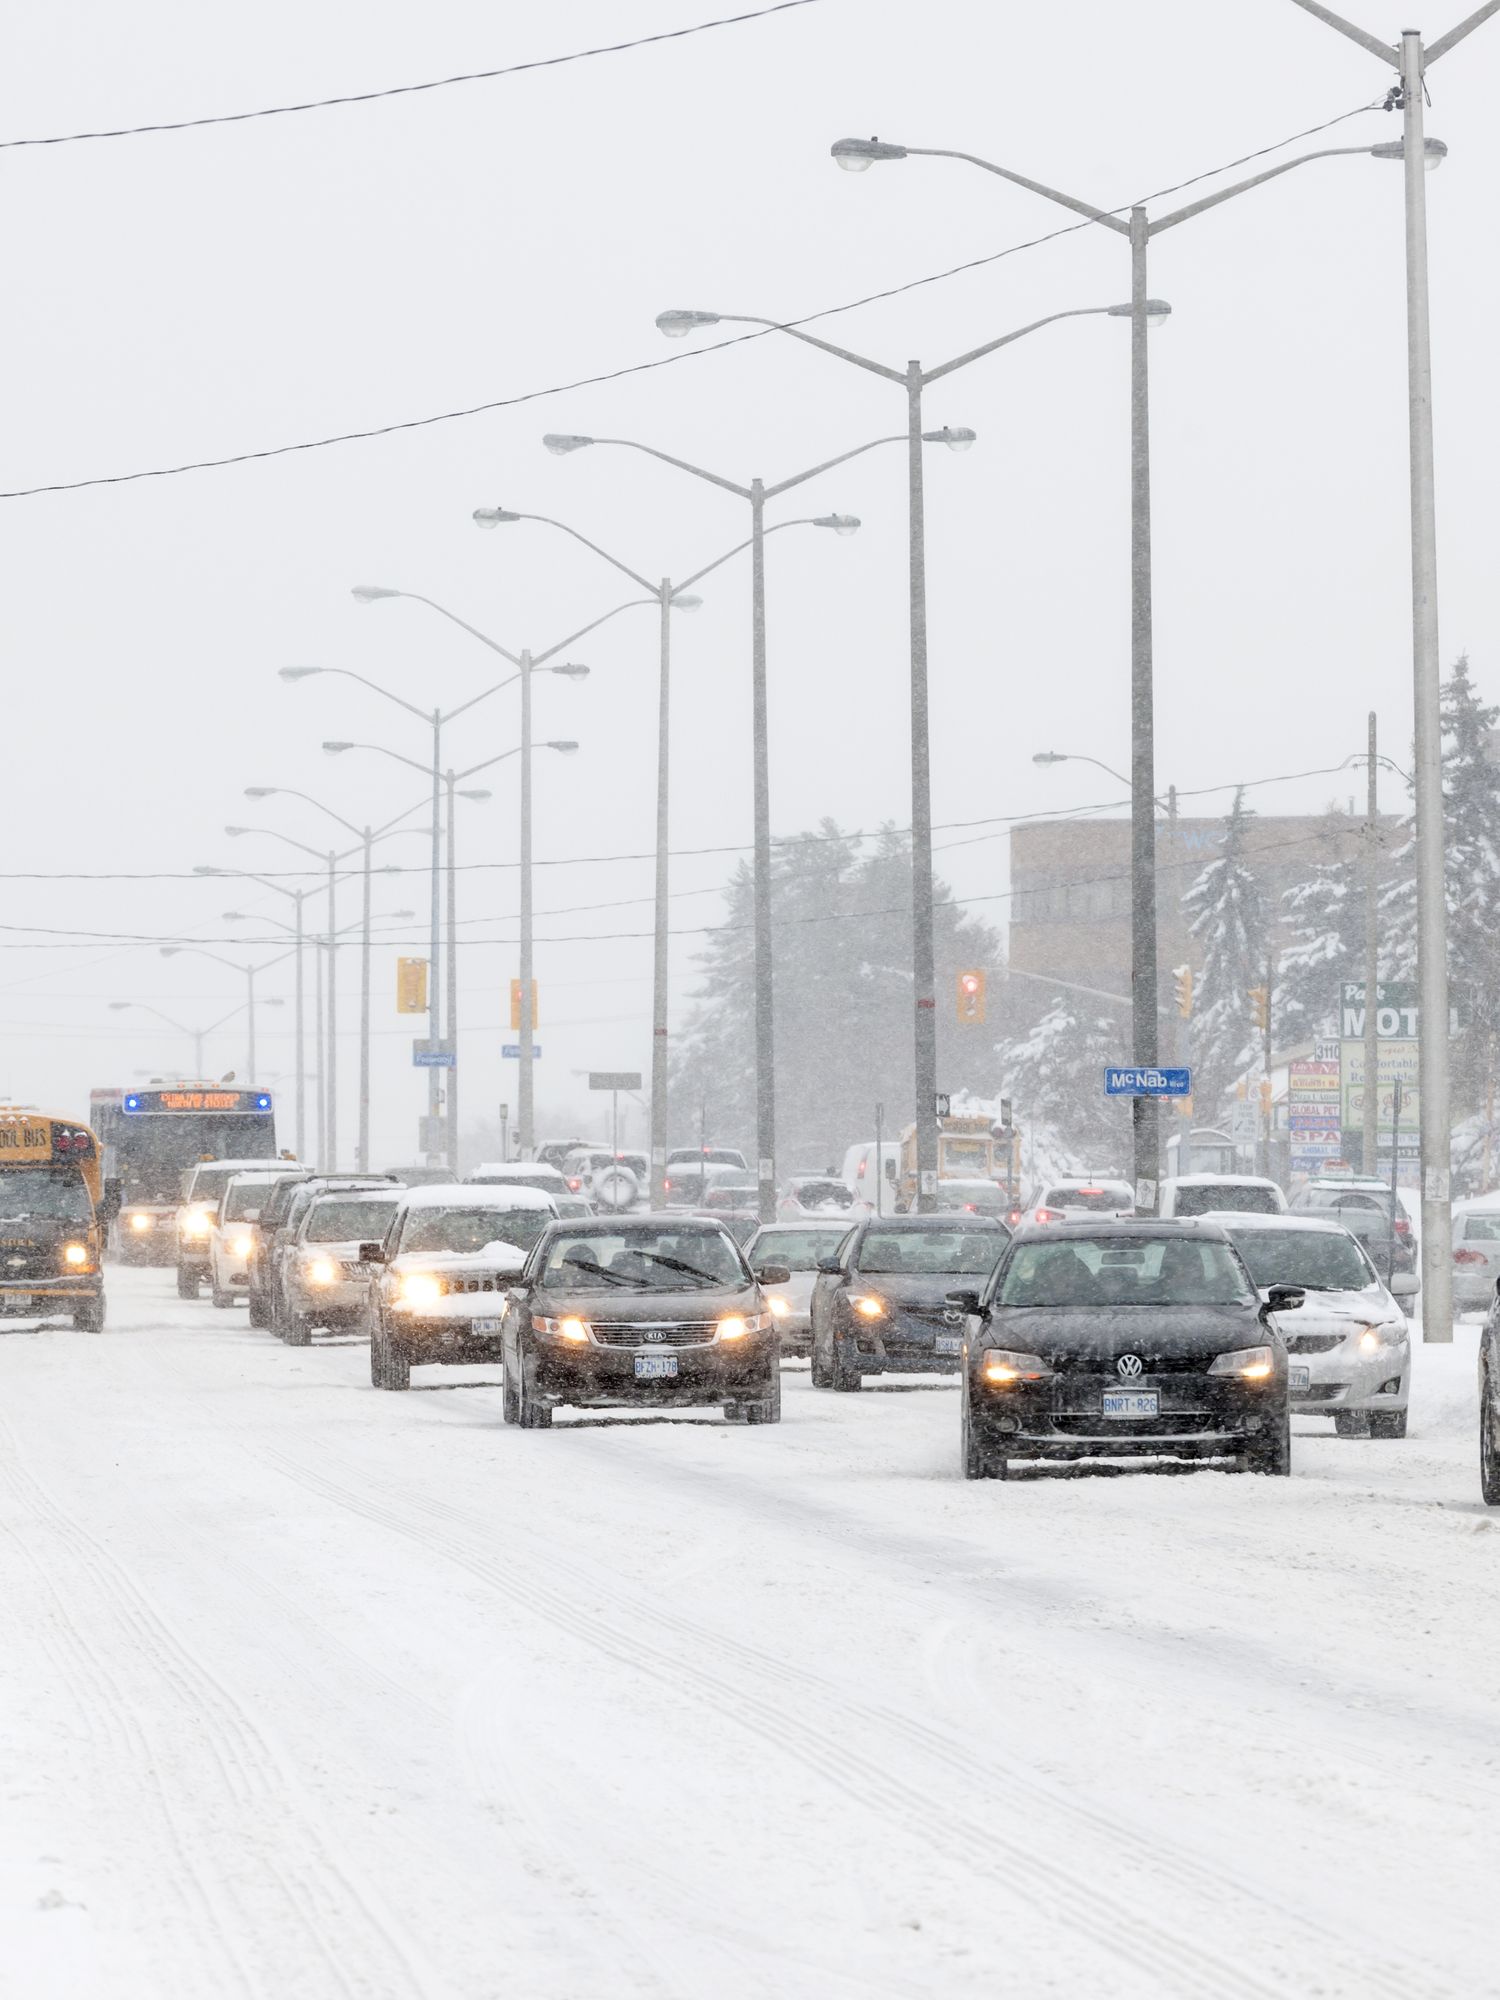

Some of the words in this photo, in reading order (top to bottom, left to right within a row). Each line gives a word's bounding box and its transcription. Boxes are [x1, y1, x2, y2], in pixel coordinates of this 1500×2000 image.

[1344, 984, 1385, 1000] Pak
[1291, 1105, 1320, 1115] GLOBAL
[1323, 1105, 1338, 1115] PET
[24, 1128, 46, 1147] BUS
[1292, 1131, 1339, 1141] SPA
[647, 1332, 663, 1340] KIA
